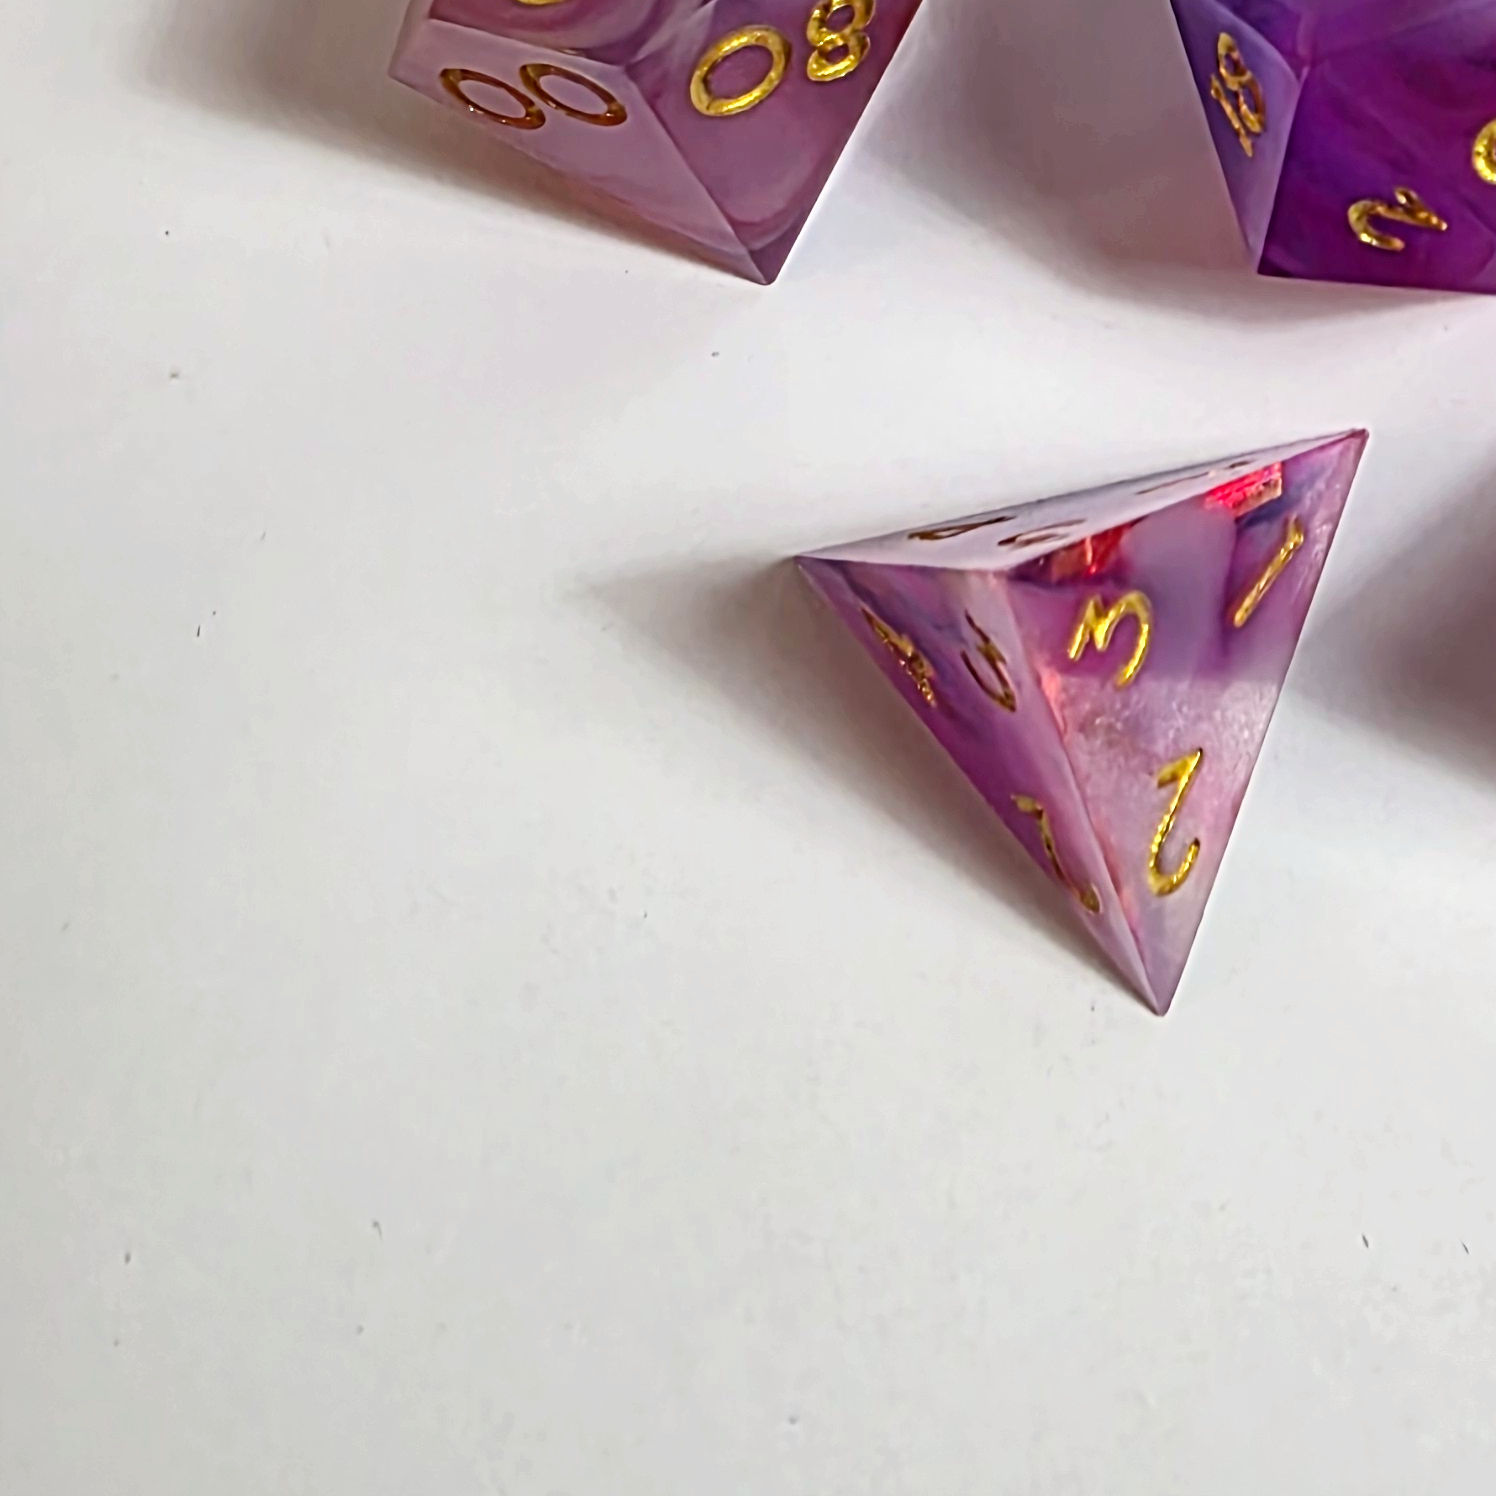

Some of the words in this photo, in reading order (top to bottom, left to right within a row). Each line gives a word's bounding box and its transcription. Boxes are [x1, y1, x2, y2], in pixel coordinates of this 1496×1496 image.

[440, 62, 628, 131] 00
[1347, 186, 1447, 252] 2
[1231, 514, 1305, 629] 1
[1067, 589, 1153, 690] 3
[1147, 746, 1204, 898] 2
